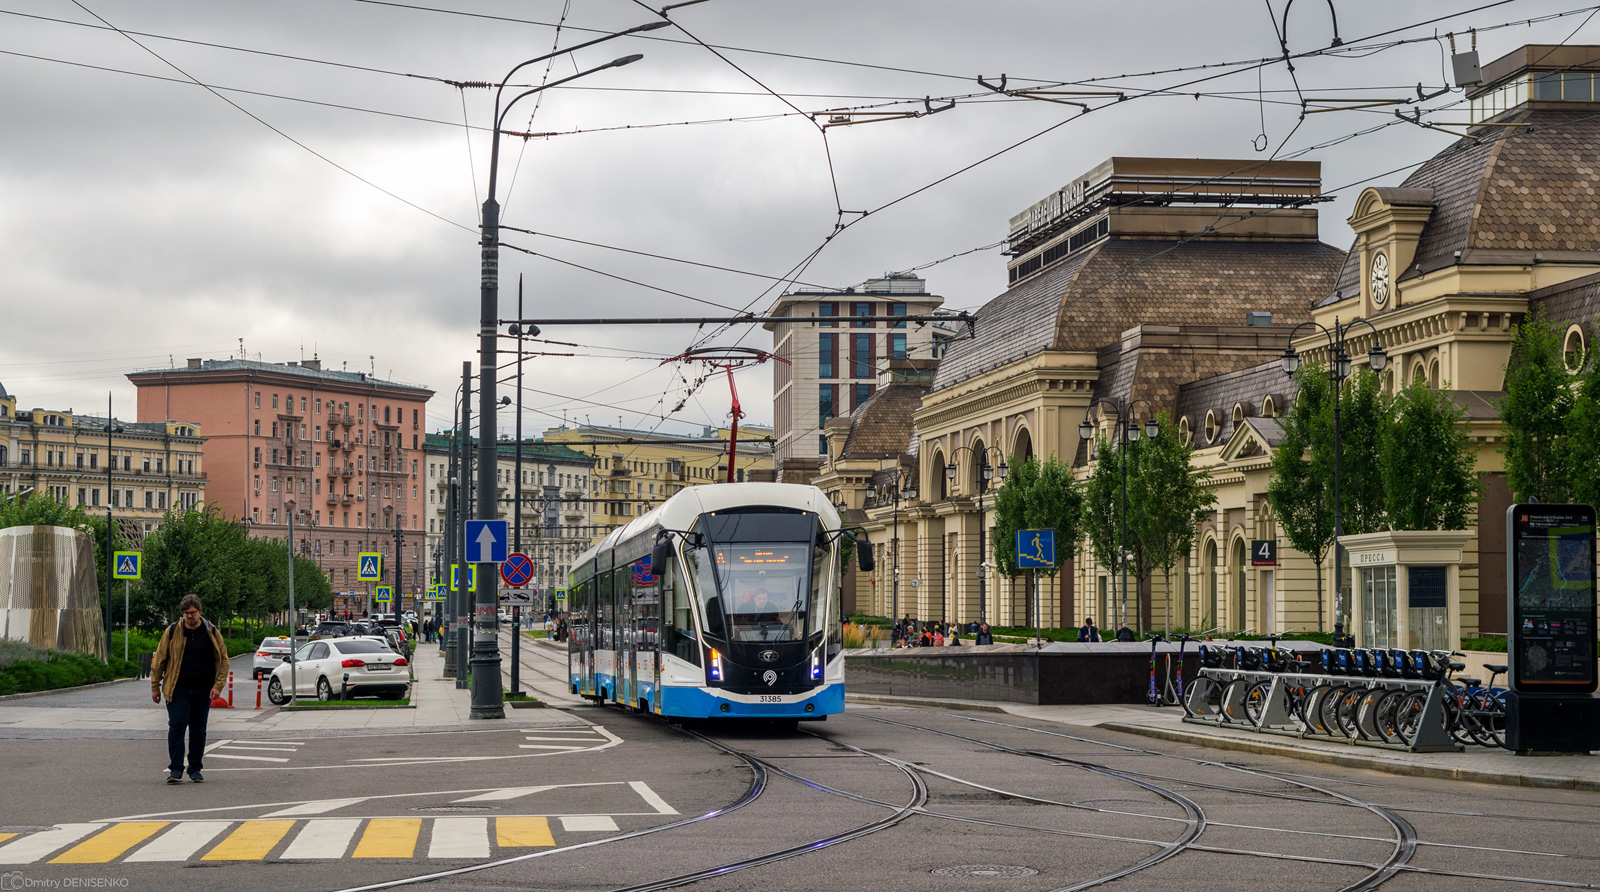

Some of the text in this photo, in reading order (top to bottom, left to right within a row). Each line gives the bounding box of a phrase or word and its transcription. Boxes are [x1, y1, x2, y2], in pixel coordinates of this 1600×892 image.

[1258, 542, 1271, 559] 4
[1360, 553, 1385, 563] ПРЕССА
[759, 695, 782, 703] 31385
